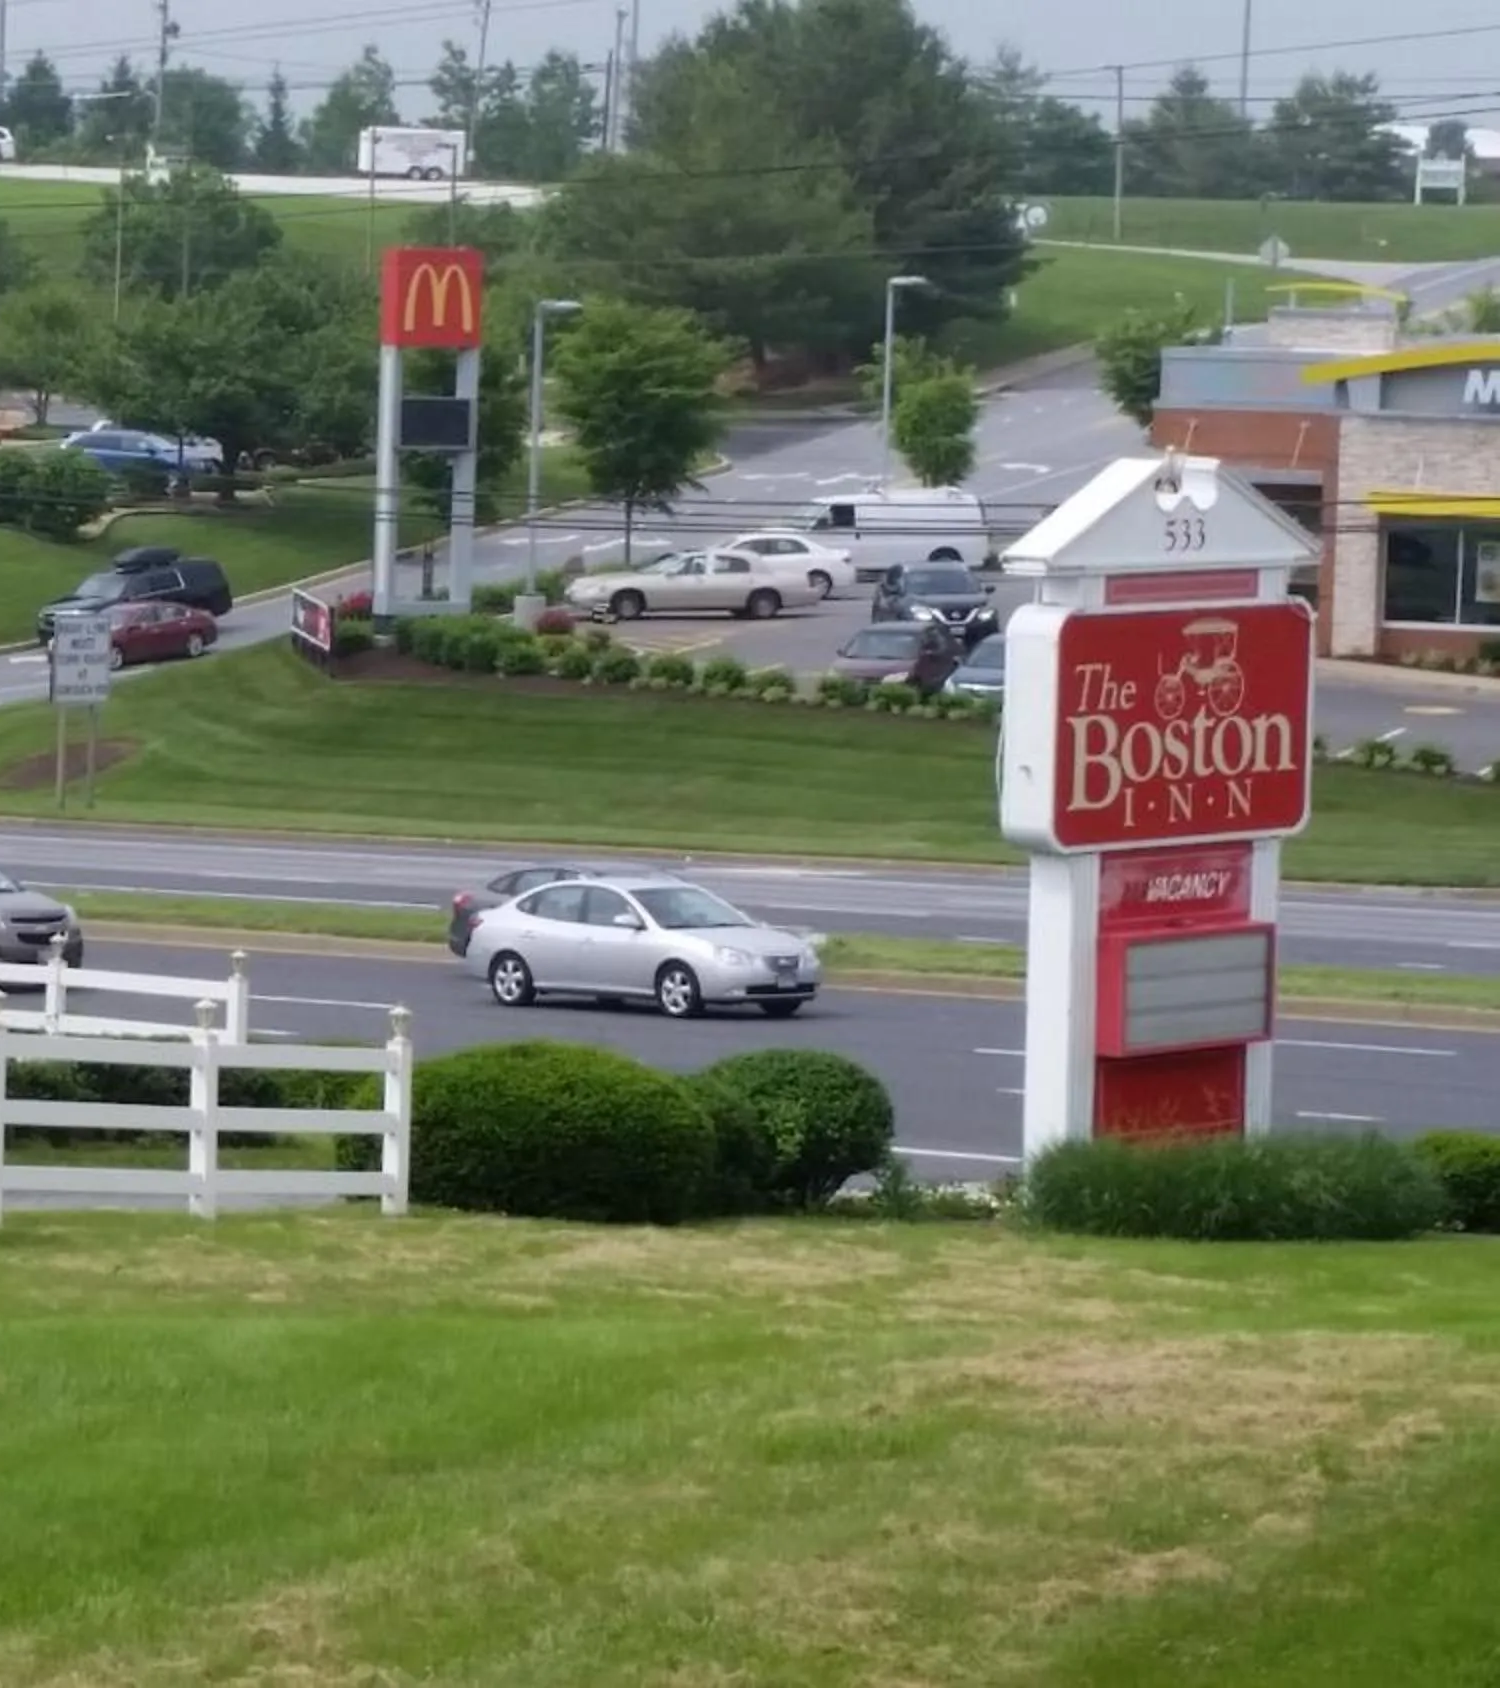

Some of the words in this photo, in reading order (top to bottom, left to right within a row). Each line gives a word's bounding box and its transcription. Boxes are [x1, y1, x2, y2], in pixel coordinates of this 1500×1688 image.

[1164, 518, 1205, 551] 533
[1075, 664, 1137, 712] The
[1066, 704, 1297, 811] Boston
[1146, 871, 1231, 902] VACANCY
